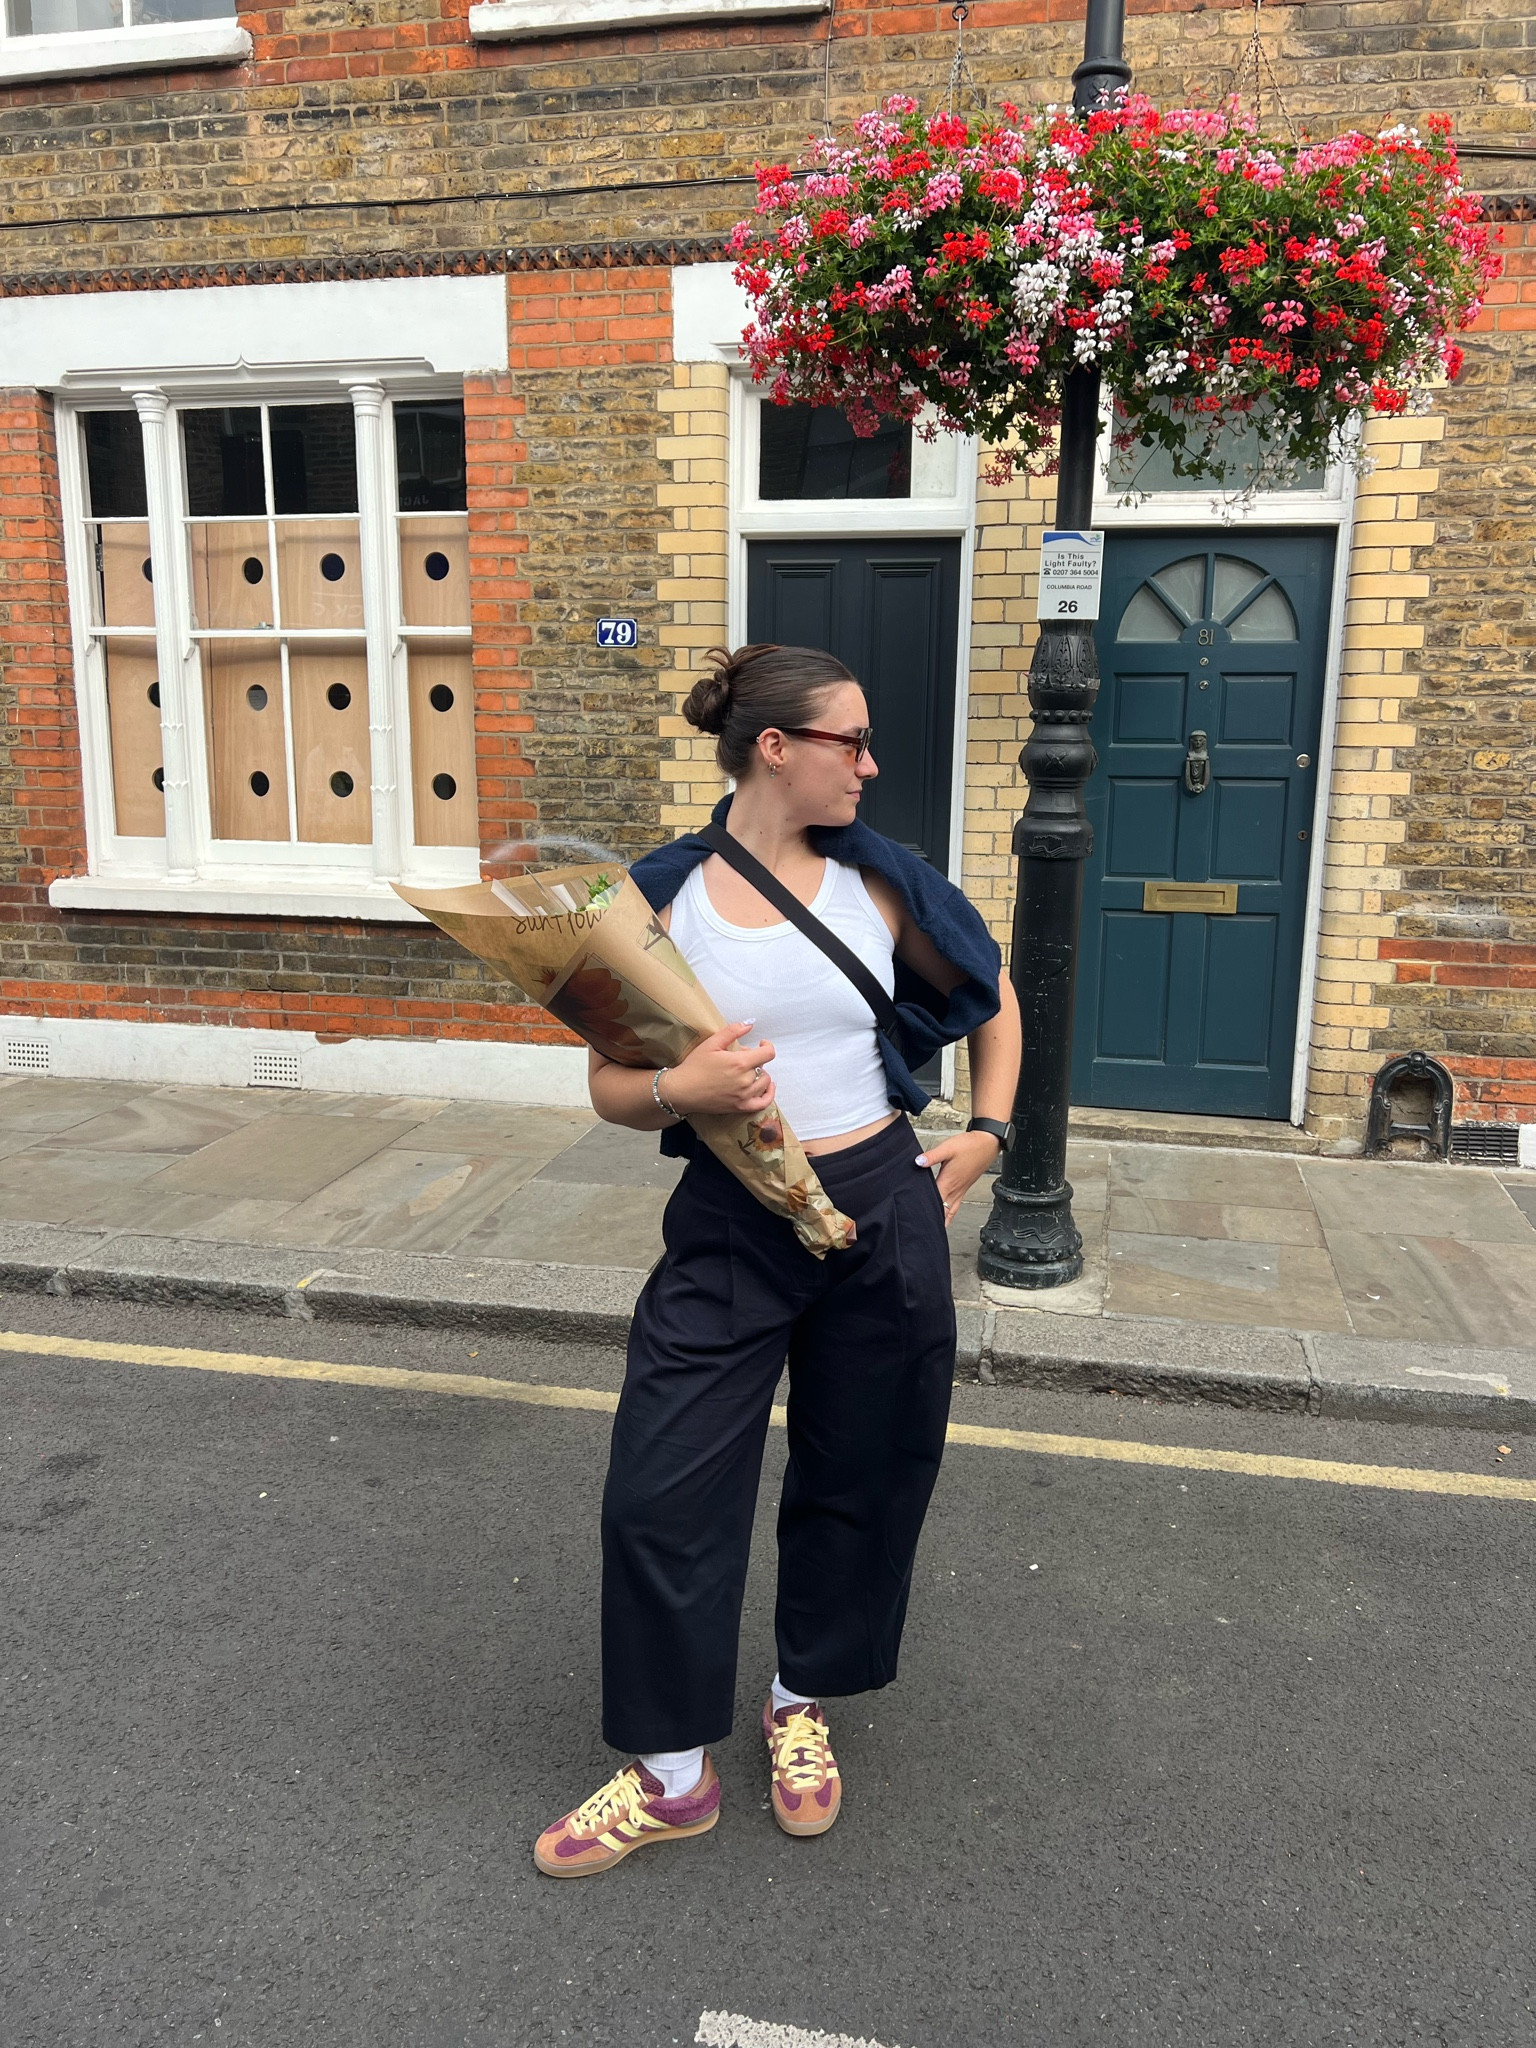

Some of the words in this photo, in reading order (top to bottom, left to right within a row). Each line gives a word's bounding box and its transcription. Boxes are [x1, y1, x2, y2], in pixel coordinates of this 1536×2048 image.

[1045, 560, 1065, 568] Light
[1068, 560, 1097, 568] Faulty?
[1058, 600, 1078, 613] 26
[601, 621, 632, 644] 79
[1198, 629, 1214, 646] 81
